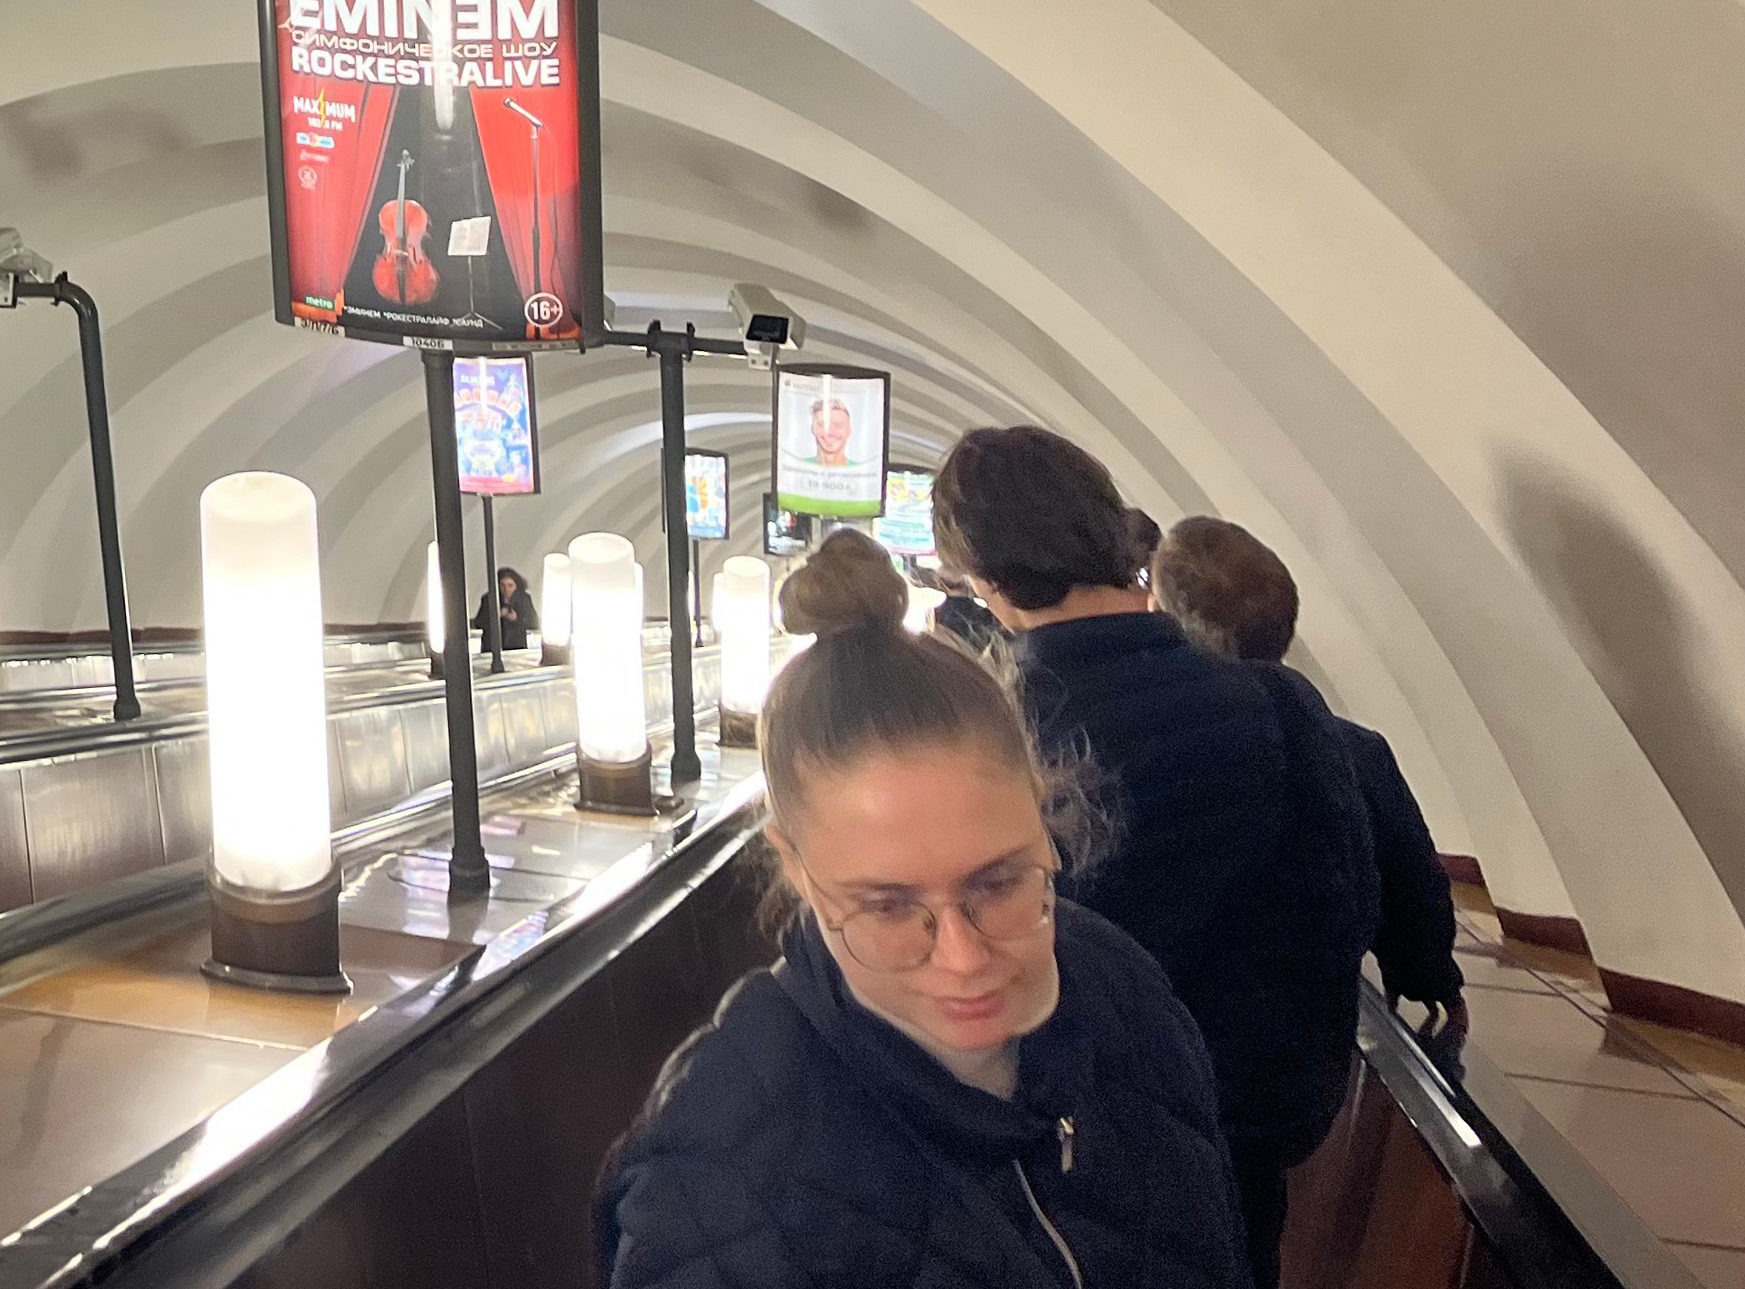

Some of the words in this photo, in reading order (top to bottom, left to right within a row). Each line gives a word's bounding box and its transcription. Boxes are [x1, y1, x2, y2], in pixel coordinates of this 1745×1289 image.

[291, 30, 494, 58] СИМФОНИЧЕКОЕ
[502, 41, 557, 58] ШОУ
[291, 45, 560, 87] ROCKESTRALIVE
[293, 94, 356, 124] MAXIMUM
[306, 295, 334, 310] metro
[530, 300, 560, 321] 16+
